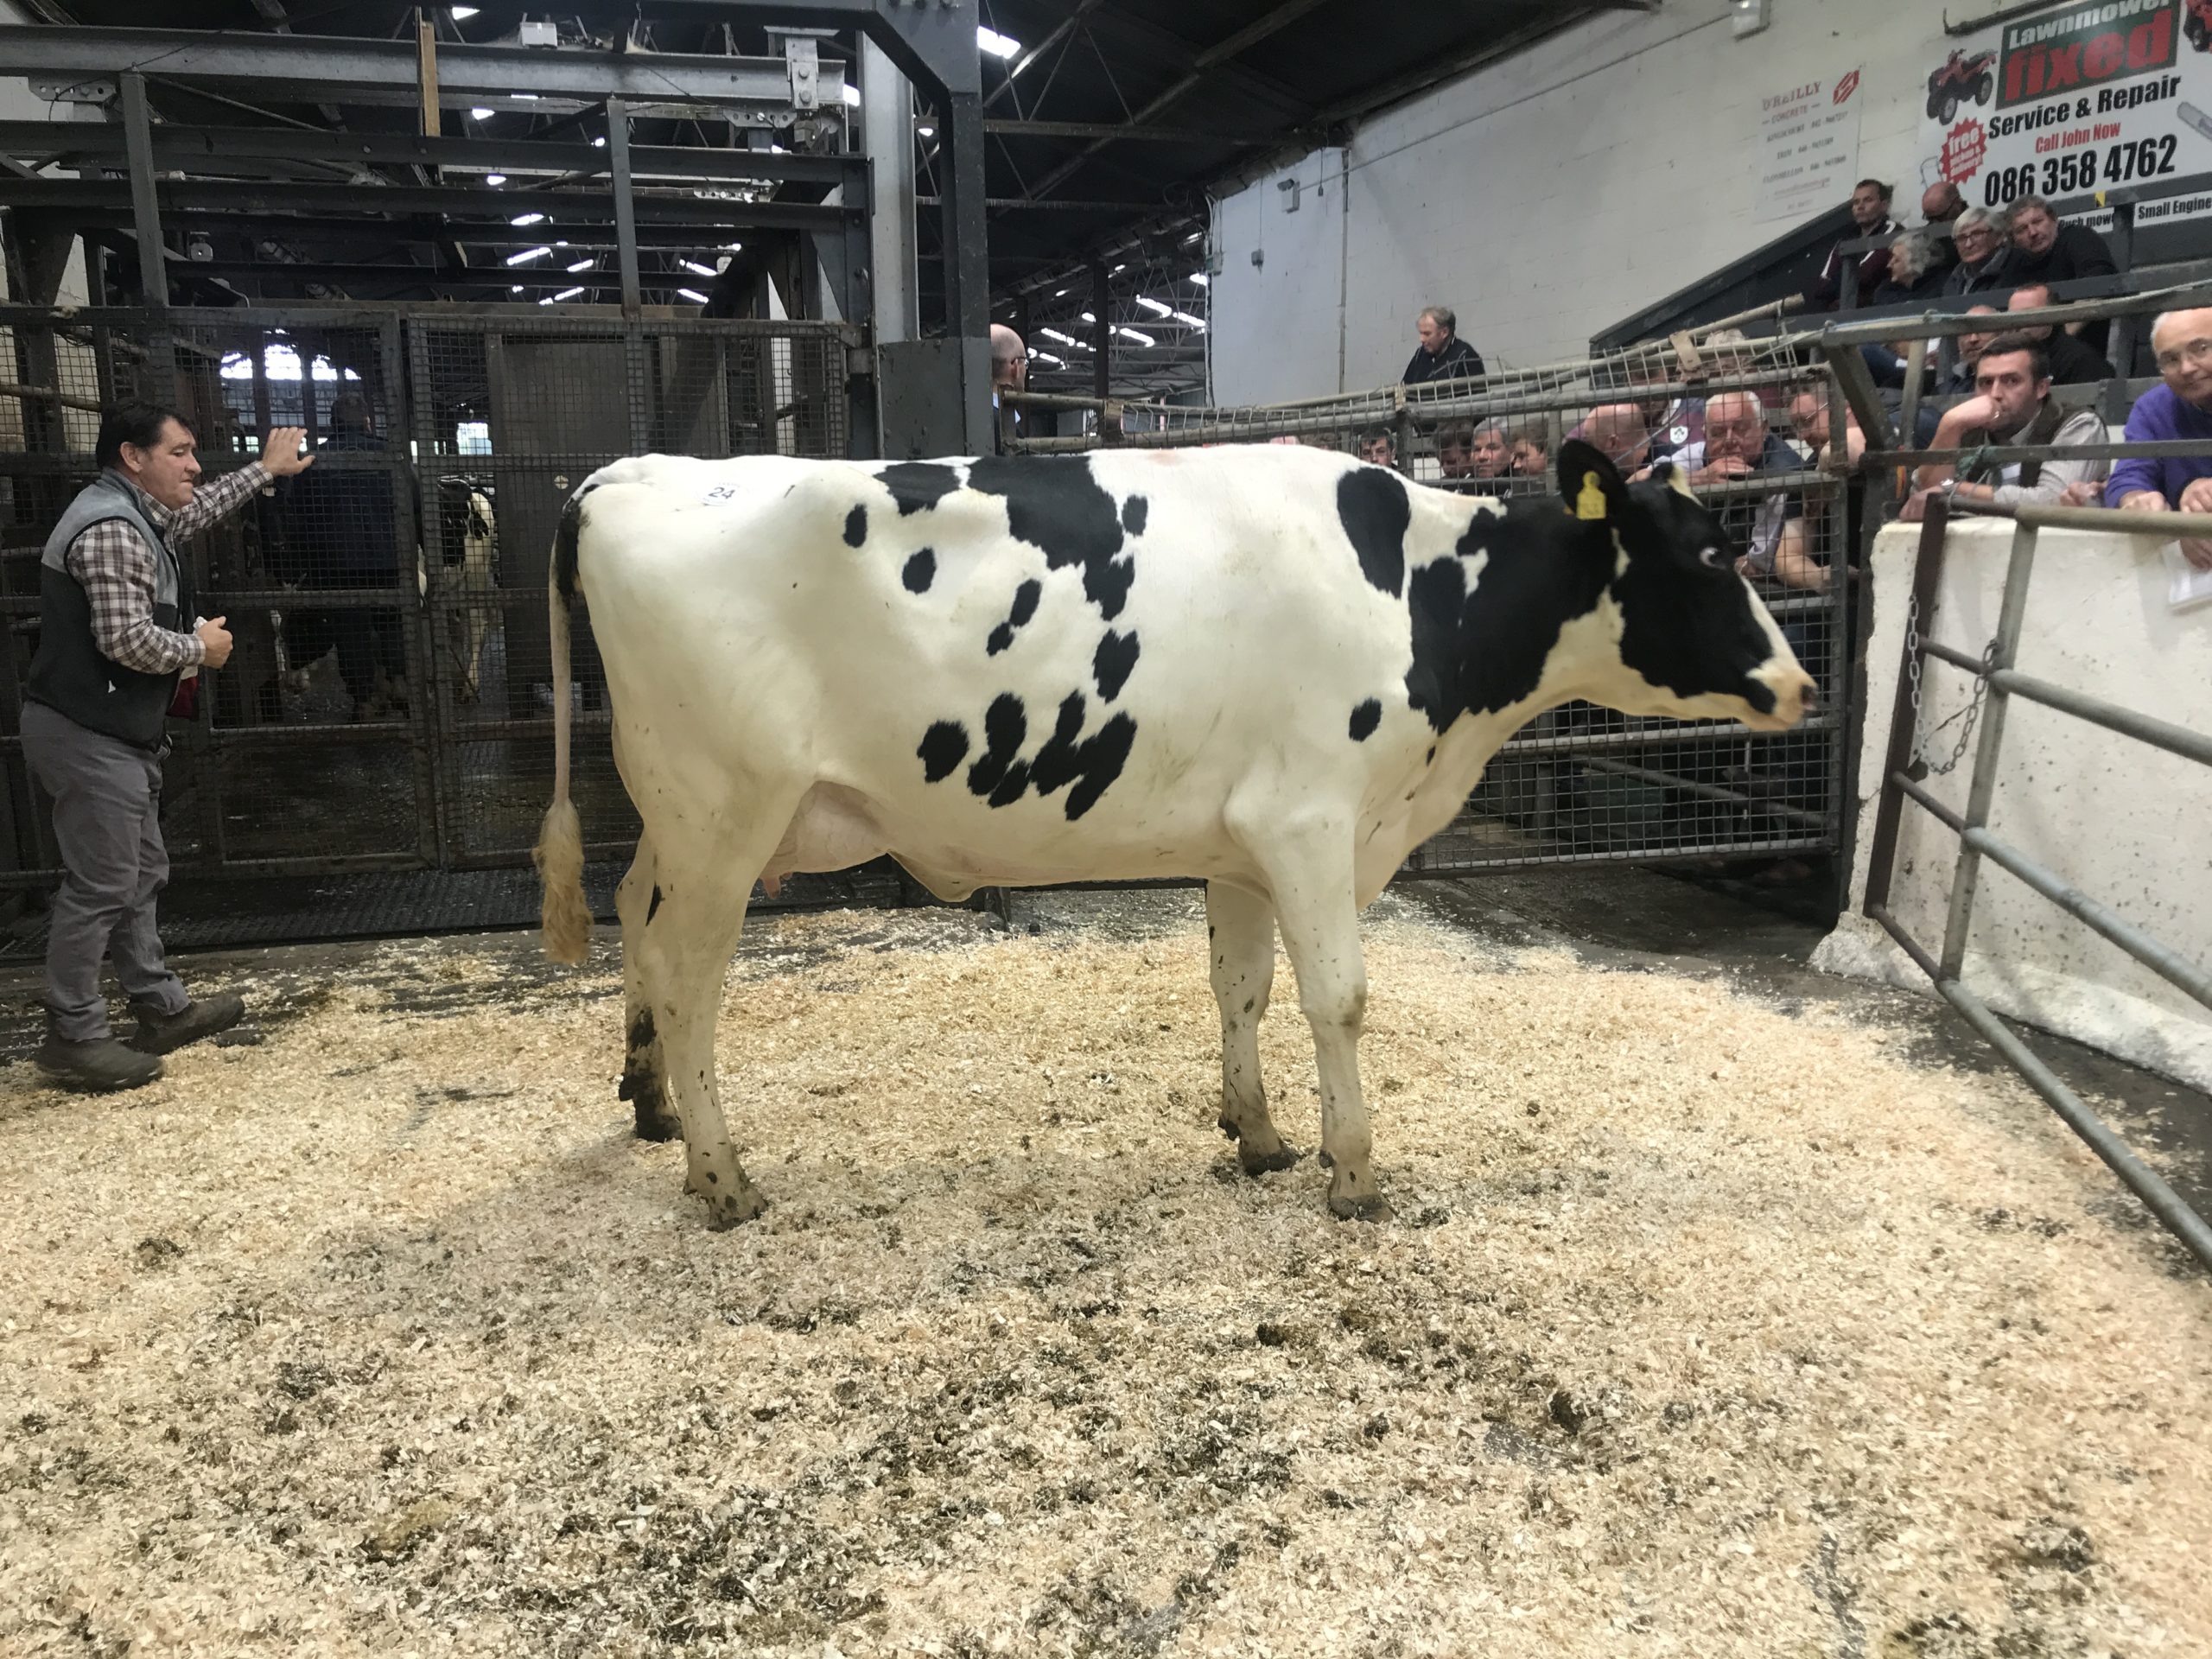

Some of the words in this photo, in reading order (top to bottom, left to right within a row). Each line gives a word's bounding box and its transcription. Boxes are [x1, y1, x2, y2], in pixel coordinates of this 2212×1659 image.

[2005, 9, 2172, 101] fixed
[1988, 101, 2070, 139] Service
[2075, 98, 2091, 118] &
[2097, 75, 2181, 113] Repair
[2035, 133, 2059, 154] Call
[2062, 127, 2090, 149] John
[2093, 123, 2121, 143] Now
[1985, 162, 2036, 207] 086
[2042, 149, 2097, 196] 358
[2103, 134, 2177, 183] 4762
[2138, 201, 2171, 219] Small
[709, 486, 735, 499] 24
